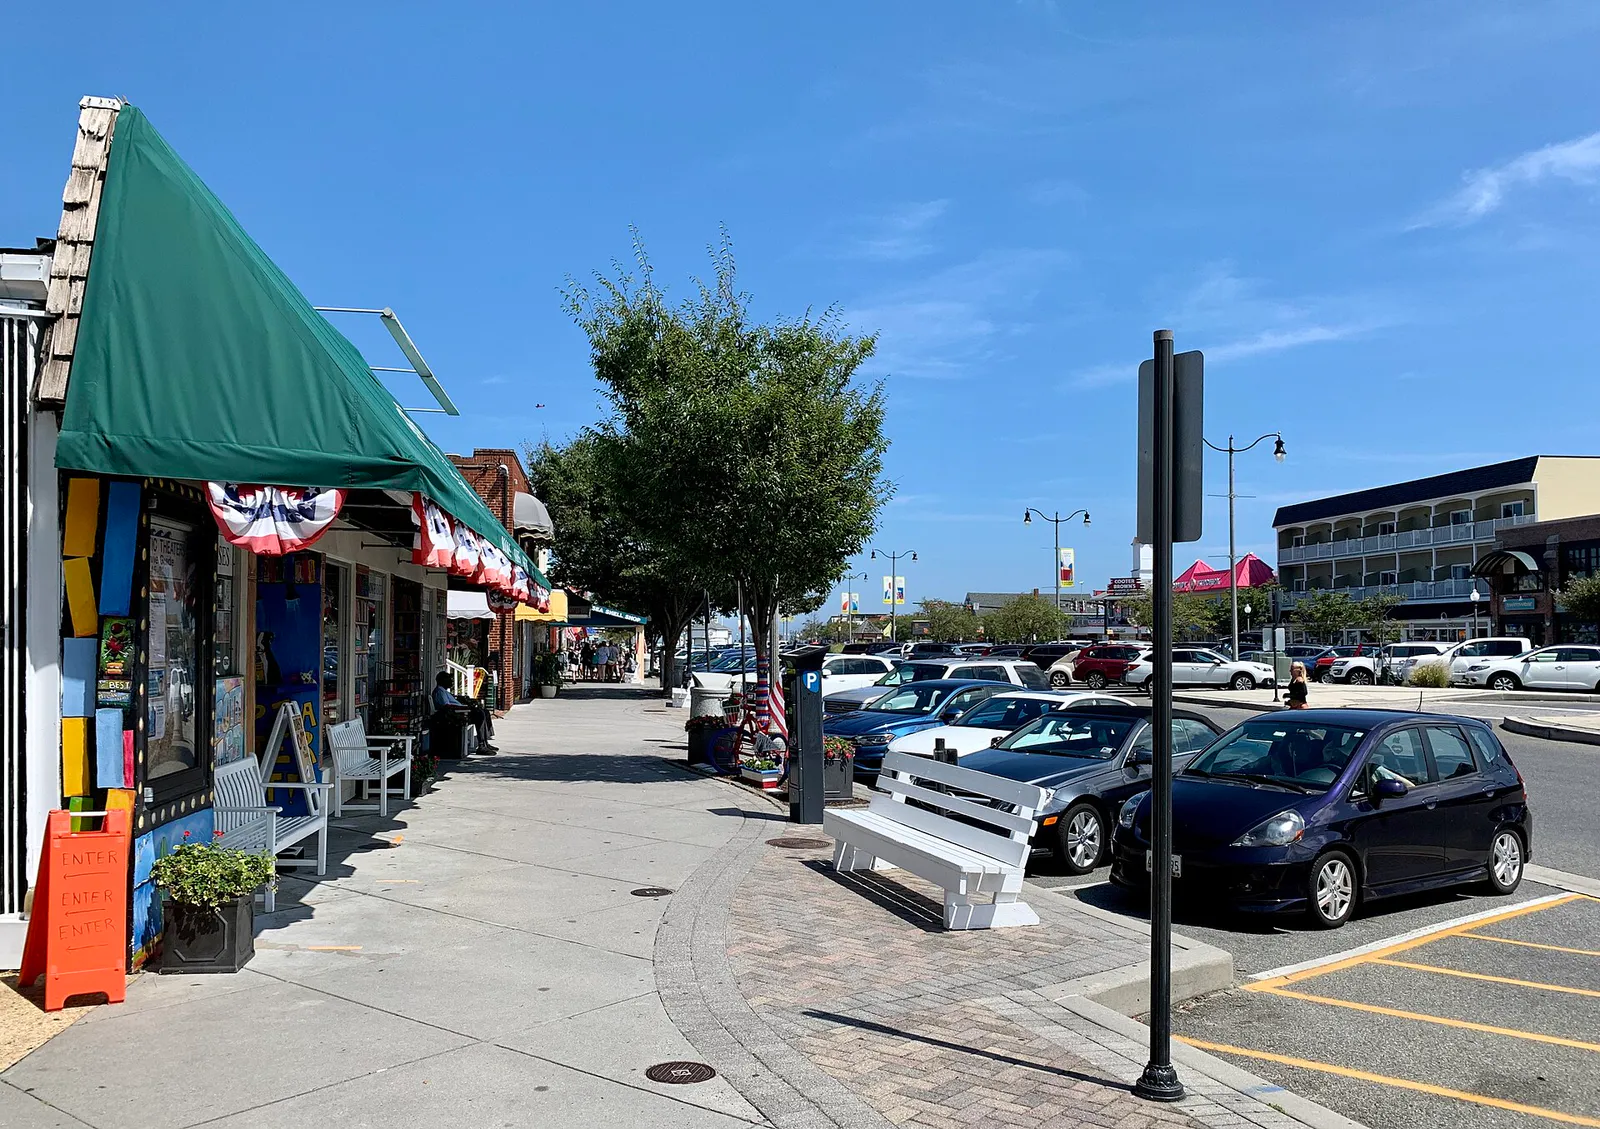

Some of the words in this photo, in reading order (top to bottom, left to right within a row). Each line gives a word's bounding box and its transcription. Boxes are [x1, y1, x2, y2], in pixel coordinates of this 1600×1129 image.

[605, 610, 623, 618] SHELL
[625, 613, 641, 622] SHOP
[108, 681, 130, 690] BEST
[807, 672, 817, 689] P
[62, 850, 118, 866] ENTER
[61, 889, 113, 906] ENTER
[59, 918, 117, 940] ENTER
